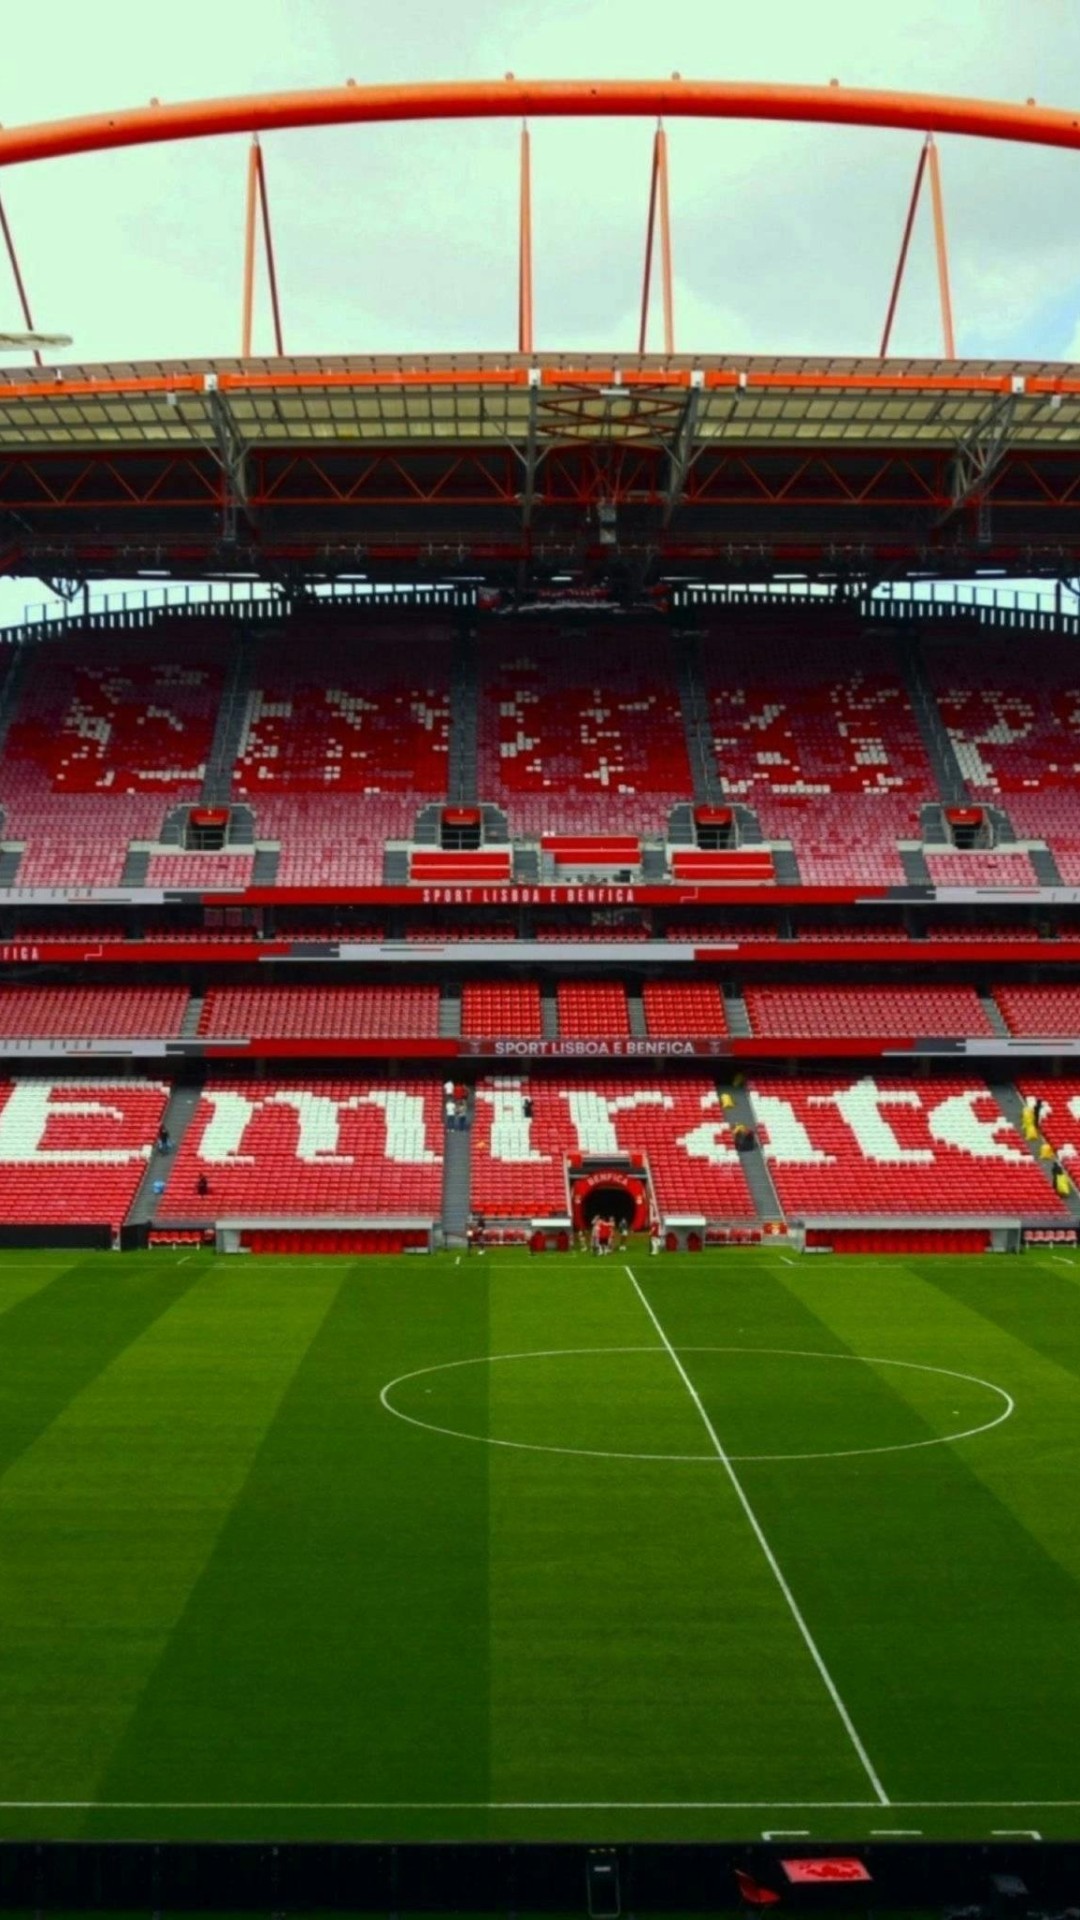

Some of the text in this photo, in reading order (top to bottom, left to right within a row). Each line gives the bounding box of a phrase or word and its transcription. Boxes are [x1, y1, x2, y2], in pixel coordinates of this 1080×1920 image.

[423, 888, 634, 903] SPORT LISBOA E BENFICA
[494, 1042, 695, 1055] SPORT LISBOA E BENFICA
[587, 1172, 628, 1186] BENFICA
